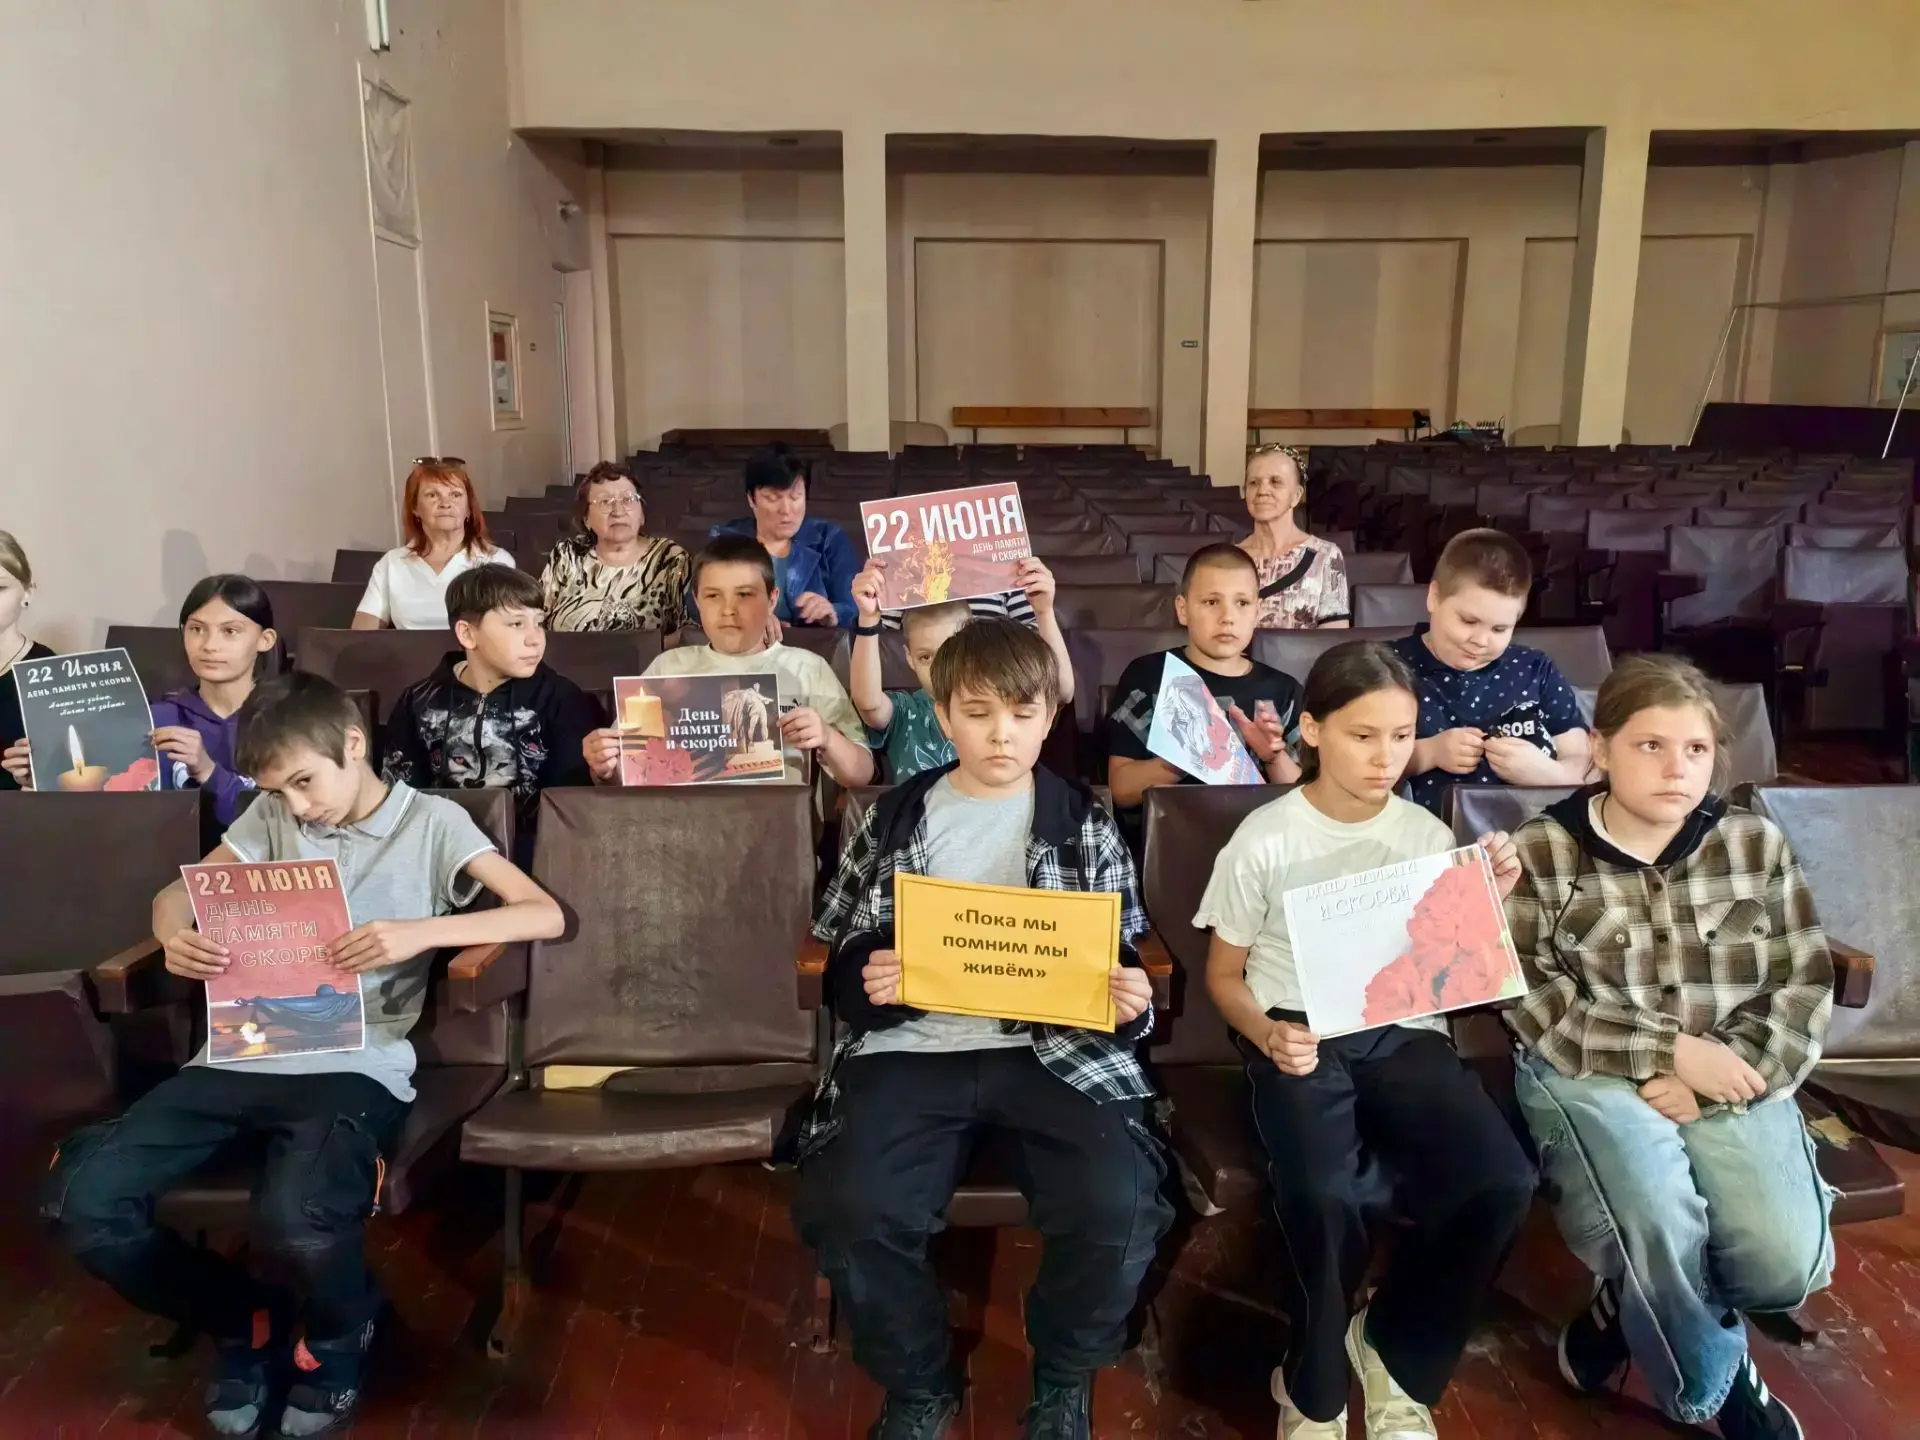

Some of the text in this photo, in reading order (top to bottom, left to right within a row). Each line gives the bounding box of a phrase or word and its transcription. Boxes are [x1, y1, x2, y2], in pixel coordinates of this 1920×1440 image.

[867, 495, 1024, 554] 22 ИЮНЯ
[973, 537, 1027, 556] ДЕНЬ ПАМЯТИ
[992, 548, 1028, 563] И СКОРБИ
[27, 659, 123, 684] 22 Июня
[27, 676, 132, 699] ДЕНЬ ПАМЯТИ И СКОРБИ
[678, 708, 720, 724] День
[669, 723, 731, 736] памяти
[666, 735, 738, 751] и скорби
[195, 865, 335, 896] 22 ИЮНЯ
[205, 899, 277, 923] ДЕНЬ
[953, 908, 1057, 932] «Пока мы
[208, 920, 318, 944] ПАМЯТИ
[240, 944, 330, 968] СКОРБ
[942, 935, 1068, 958] помним мы
[963, 961, 1047, 979] живём»
